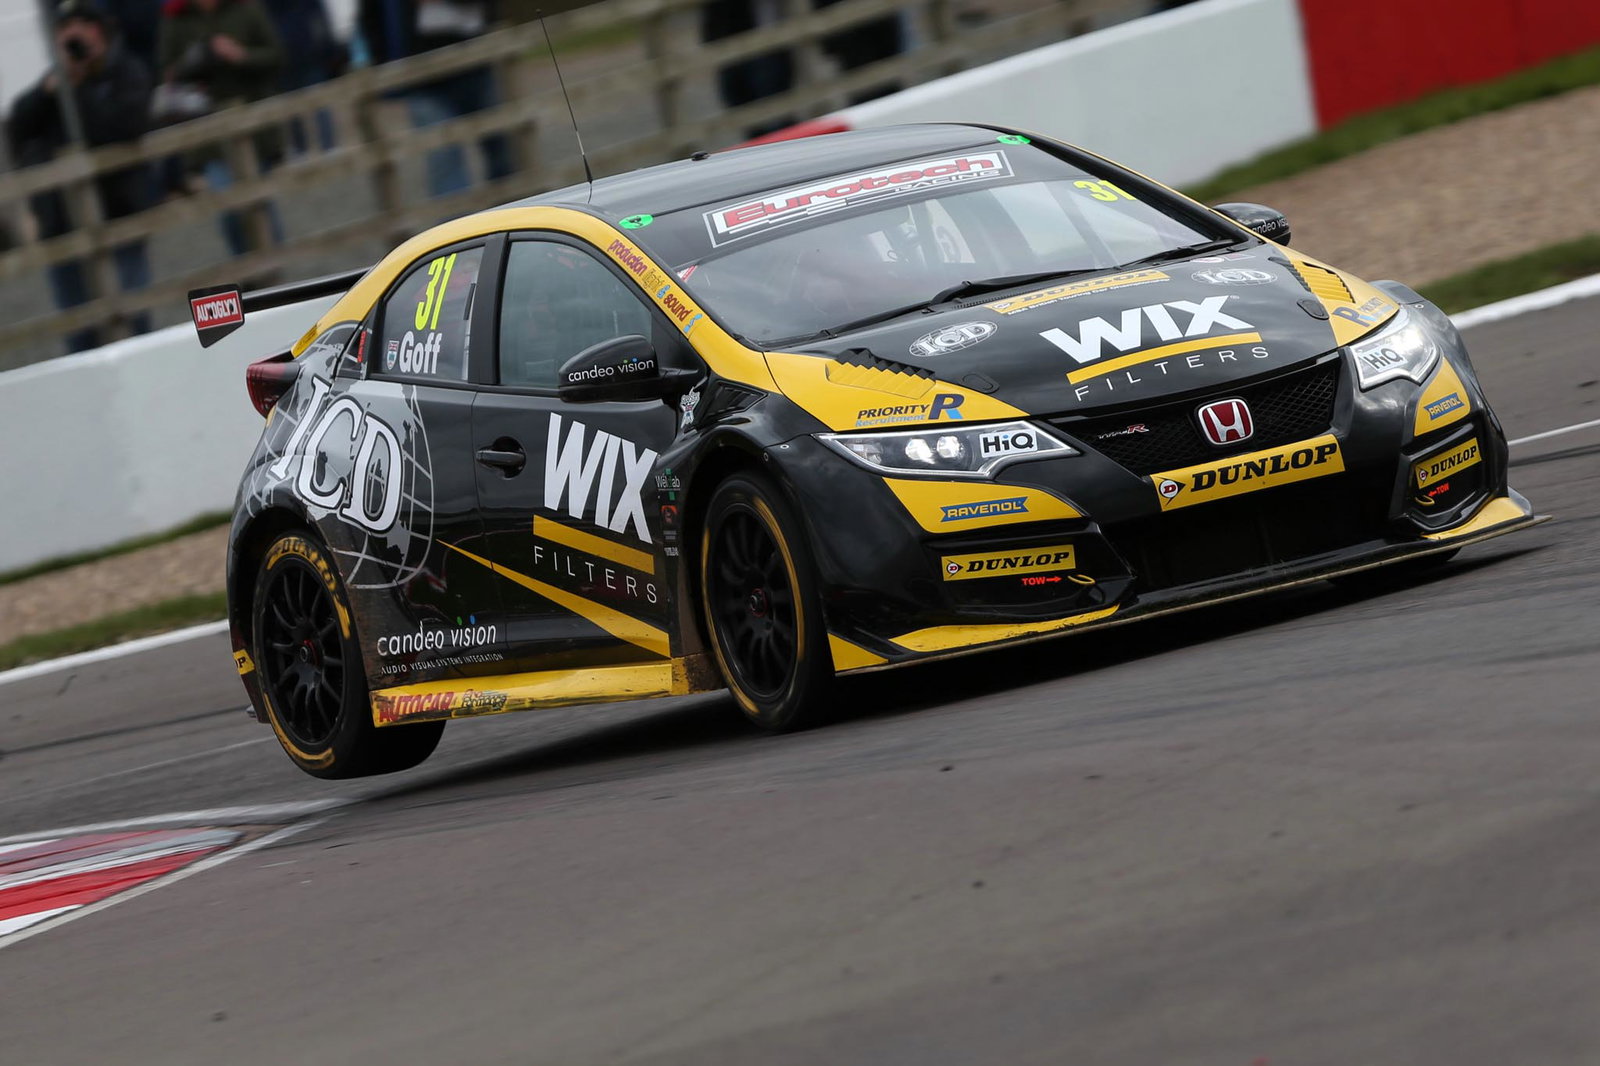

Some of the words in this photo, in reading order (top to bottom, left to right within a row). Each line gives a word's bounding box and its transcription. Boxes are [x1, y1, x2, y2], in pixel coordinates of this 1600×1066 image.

[723, 158, 995, 228] Eurotech
[894, 170, 1000, 192] RACING
[1073, 180, 1137, 202] 31
[414, 253, 457, 331] 31
[607, 239, 648, 277] production
[663, 293, 693, 322] sound
[1029, 299, 1058, 309] British
[1060, 291, 1092, 301] Touring
[914, 323, 993, 355] ICD
[1039, 294, 1256, 364] WIX
[399, 331, 442, 375] Goff
[1363, 348, 1404, 369] HiQ
[568, 365, 615, 382] candeo
[617, 357, 655, 374] vision
[1074, 346, 1270, 402] FILTERS
[857, 404, 930, 419] PRIORITY
[1428, 397, 1461, 415] RAVENOL
[854, 414, 926, 427] Recruitment
[269, 376, 403, 532] ICD
[982, 432, 1034, 454] HiQ
[1190, 442, 1338, 492] DUNLOP
[1431, 446, 1477, 477] DUNLOP
[544, 412, 658, 545] WIX
[1436, 483, 1450, 493] TOW
[946, 501, 1022, 518] RAVENOL
[533, 545, 658, 604] FILTERS
[966, 551, 1070, 573] DUNLOP
[1021, 576, 1046, 586] TOW
[377, 620, 444, 656] candeo
[450, 613, 497, 648] vision
[381, 664, 408, 675] AUDIO
[410, 660, 436, 671] VISUAL
[436, 656, 463, 667] SYSTEMS
[464, 653, 504, 663] INTEGRATION
[379, 691, 455, 723] AUTOCAR
